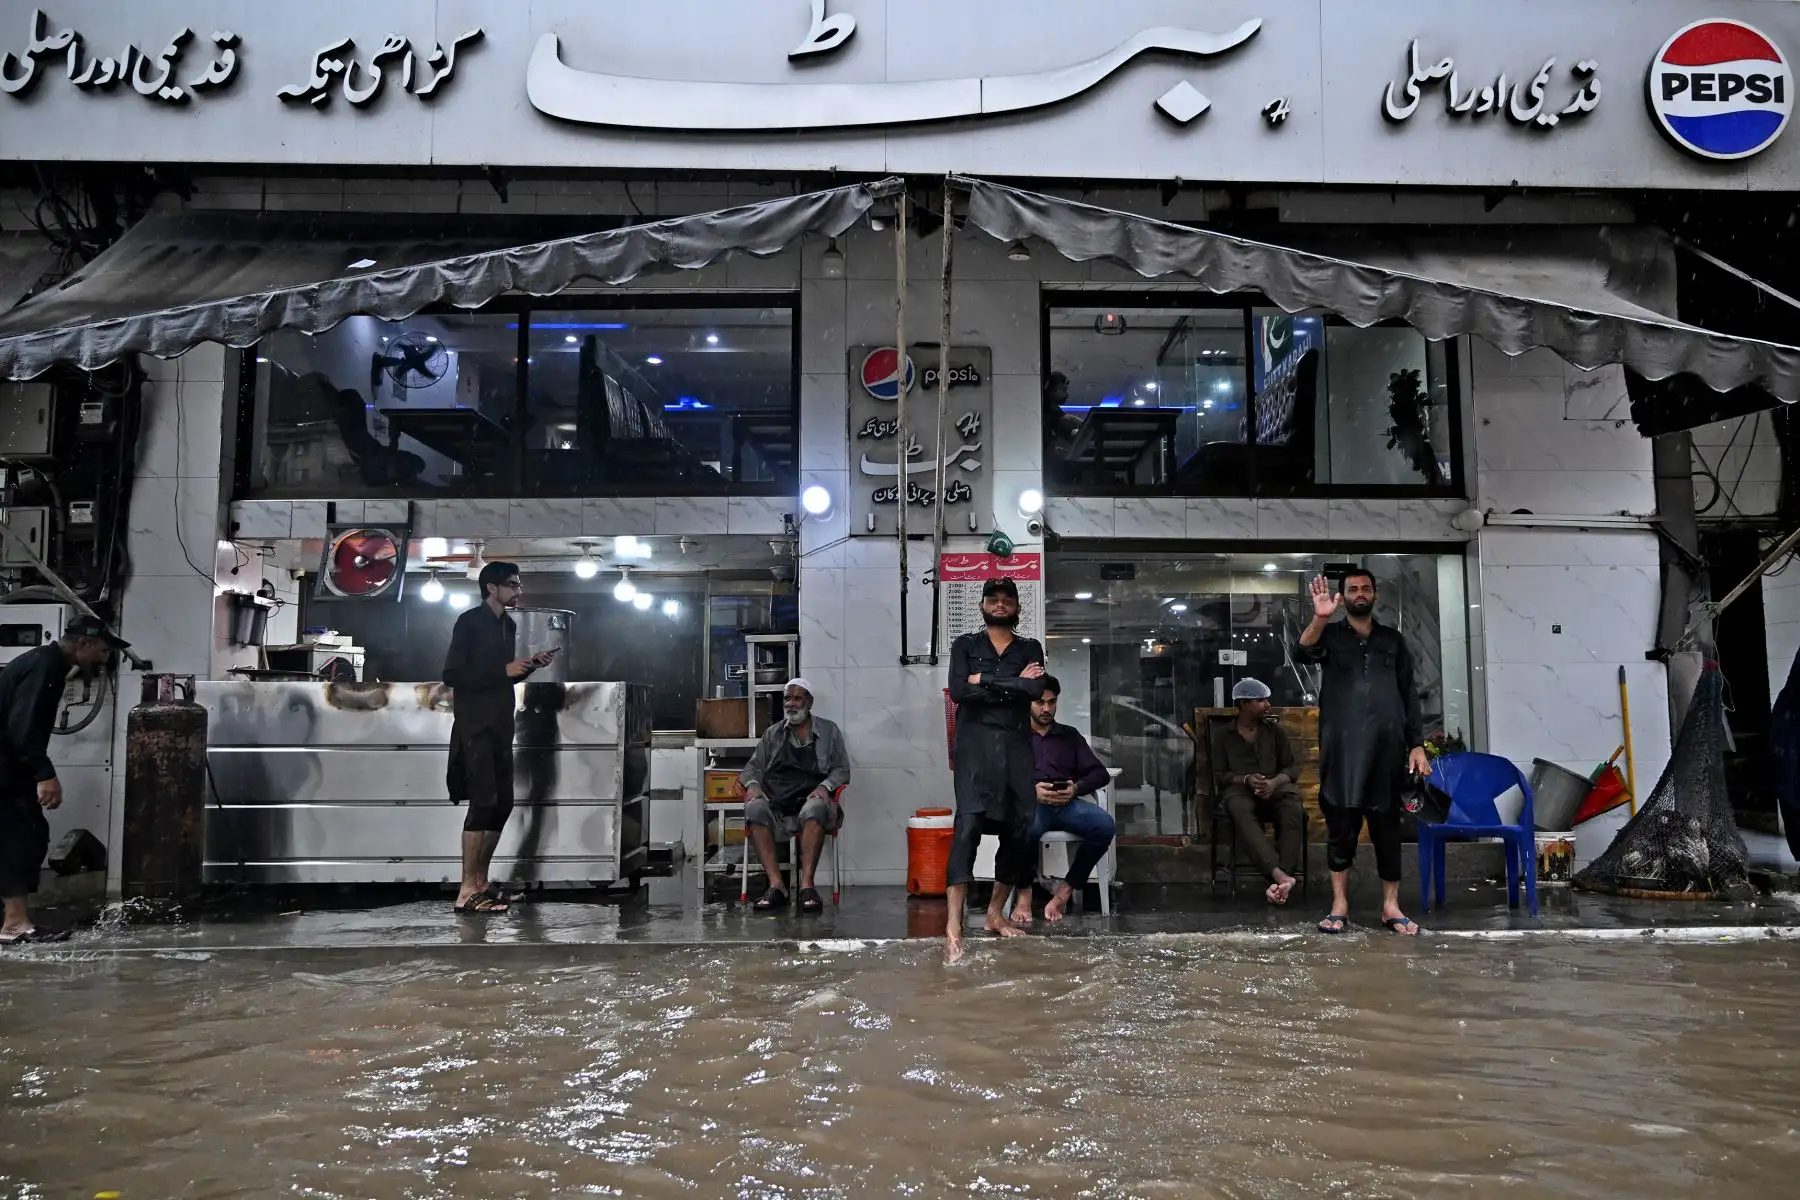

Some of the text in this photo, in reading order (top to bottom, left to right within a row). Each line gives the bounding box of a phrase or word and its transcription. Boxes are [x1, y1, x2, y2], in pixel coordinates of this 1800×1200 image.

[72, 43, 136, 85] اور
[1454, 72, 1506, 112] اور
[1661, 72, 1785, 104] PEPSI
